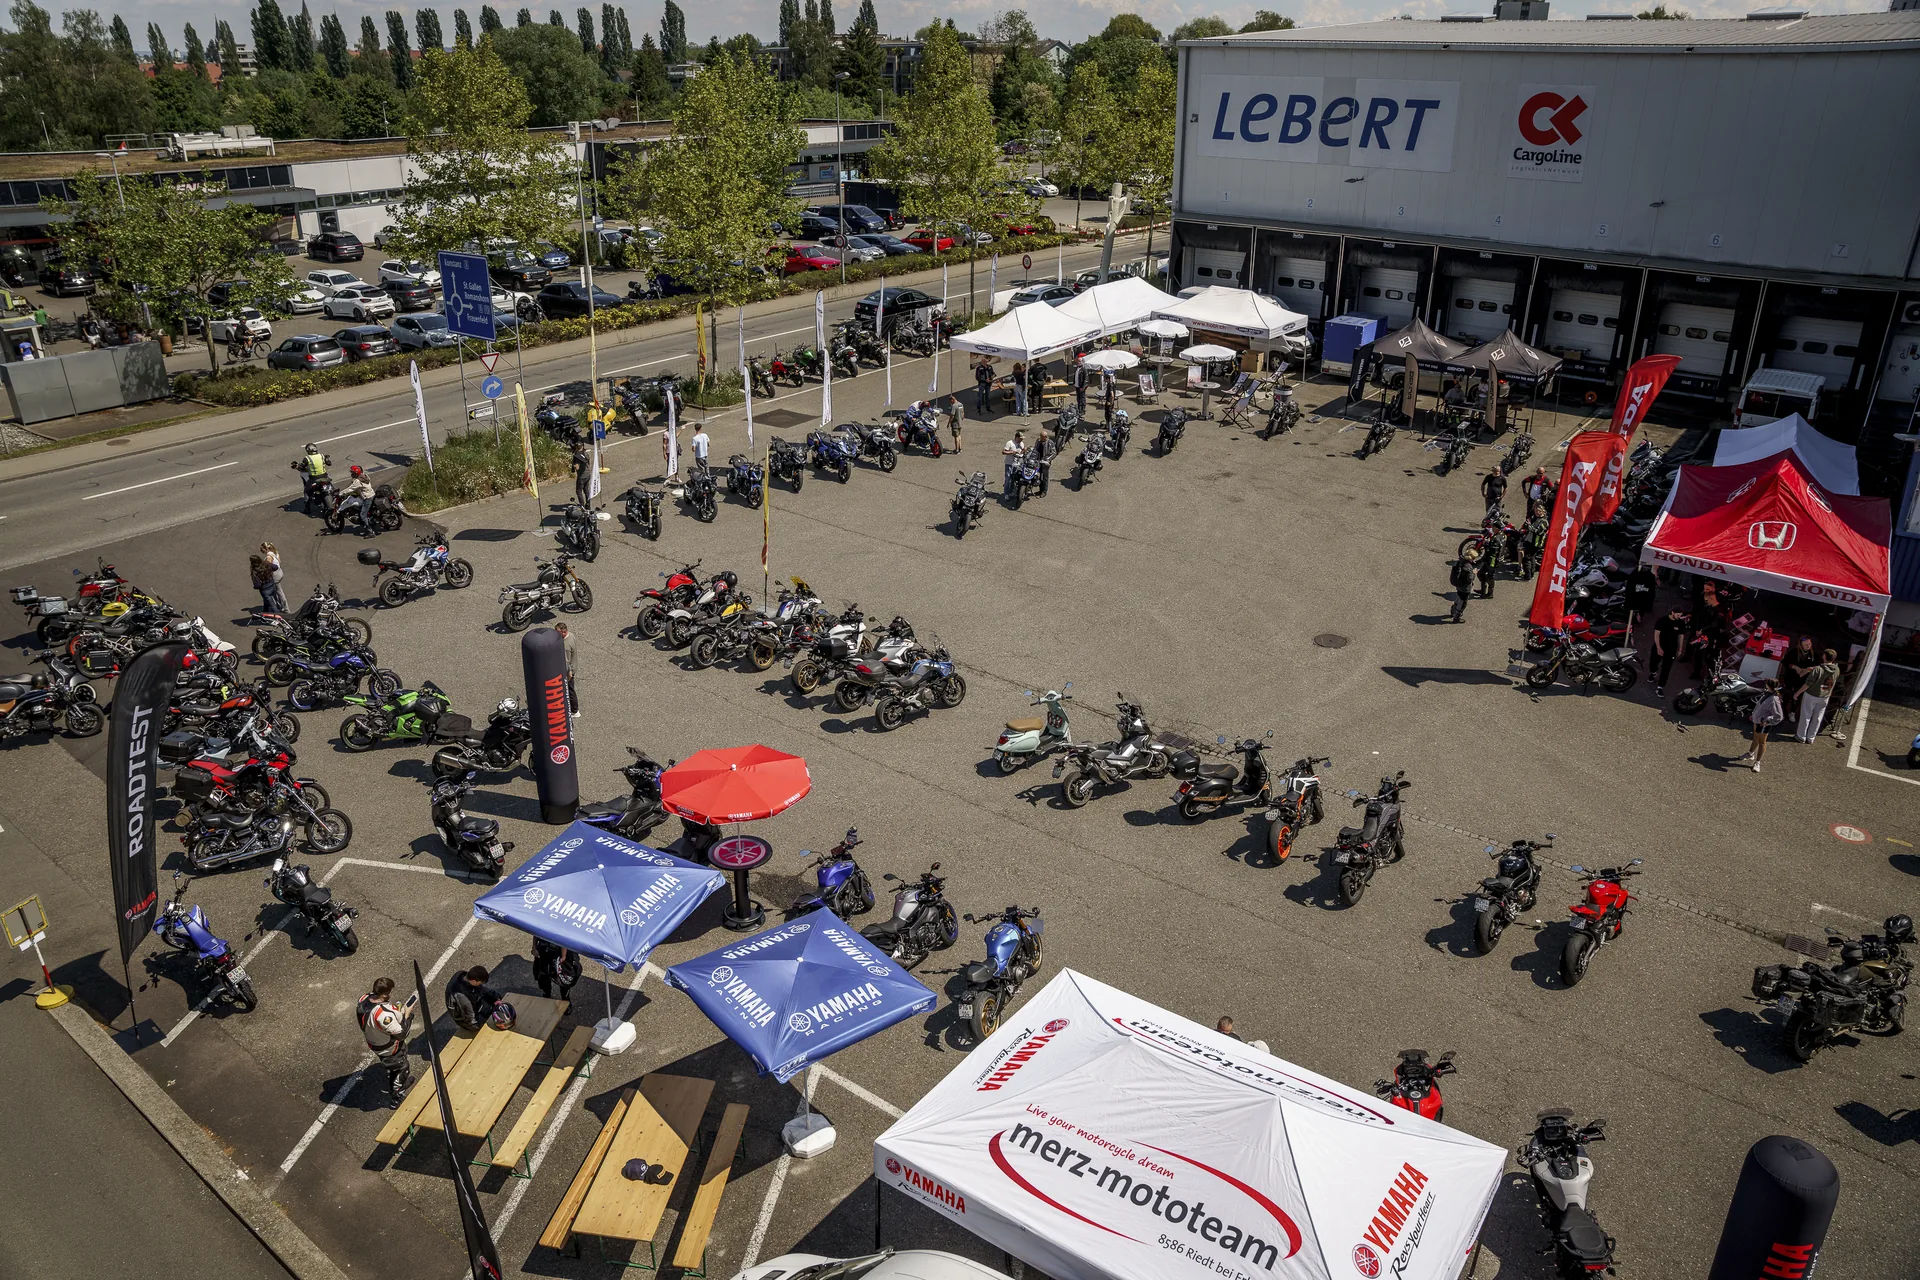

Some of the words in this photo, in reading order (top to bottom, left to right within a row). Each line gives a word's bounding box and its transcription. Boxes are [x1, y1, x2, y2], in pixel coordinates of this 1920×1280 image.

[1513, 147, 1582, 166] CargoLine
[1224, 192, 1229, 201] 1
[1307, 199, 1313, 208] 2
[1398, 206, 1404, 216] 3
[1495, 215, 1501, 225] 4
[1599, 225, 1606, 235] 5
[1712, 235, 1719, 245] 6
[1838, 245, 1846, 255] 7
[444, 258, 462, 268] Konstanz
[464, 292, 489, 303] Romanshorn
[467, 313, 488, 325] Frauenfeld
[596, 422, 602, 436] P
[1549, 460, 1597, 594] HONDA
[1653, 550, 1727, 575] HONDA
[1789, 580, 1874, 607] HONDA
[545, 674, 568, 746] YAMAHA
[129, 705, 153, 858] ROADTEST
[520, 848, 575, 883] YAMAHA
[595, 836, 654, 862] YAMAHA
[543, 893, 609, 931] YAMAHA
[630, 873, 681, 915] YAMAHA
[638, 884, 684, 928] RACING
[524, 904, 595, 934] RACING
[721, 930, 794, 960] YAMAHA
[822, 928, 873, 971] YAMAHA
[707, 980, 757, 1029] RACING
[724, 975, 776, 1028] YAMAHA
[805, 982, 883, 1023] YAMAHA
[805, 999, 883, 1036] RACING
[976, 1034, 1056, 1091] YAMAHA
[1130, 1021, 1377, 1121] merz-mototeam
[1026, 1103, 1048, 1119] Live
[1048, 1114, 1075, 1131] your
[1076, 1129, 1136, 1162] motorcycle
[1137, 1155, 1175, 1180] dream
[903, 1165, 966, 1214] YAMAHA
[1008, 1122, 1279, 1272] merz-mototeam
[1363, 1162, 1429, 1255] YAMAHA
[1157, 1234, 1184, 1254] 8586
[1185, 1247, 1215, 1269] Riedt
[1215, 1261, 1233, 1280] bei
